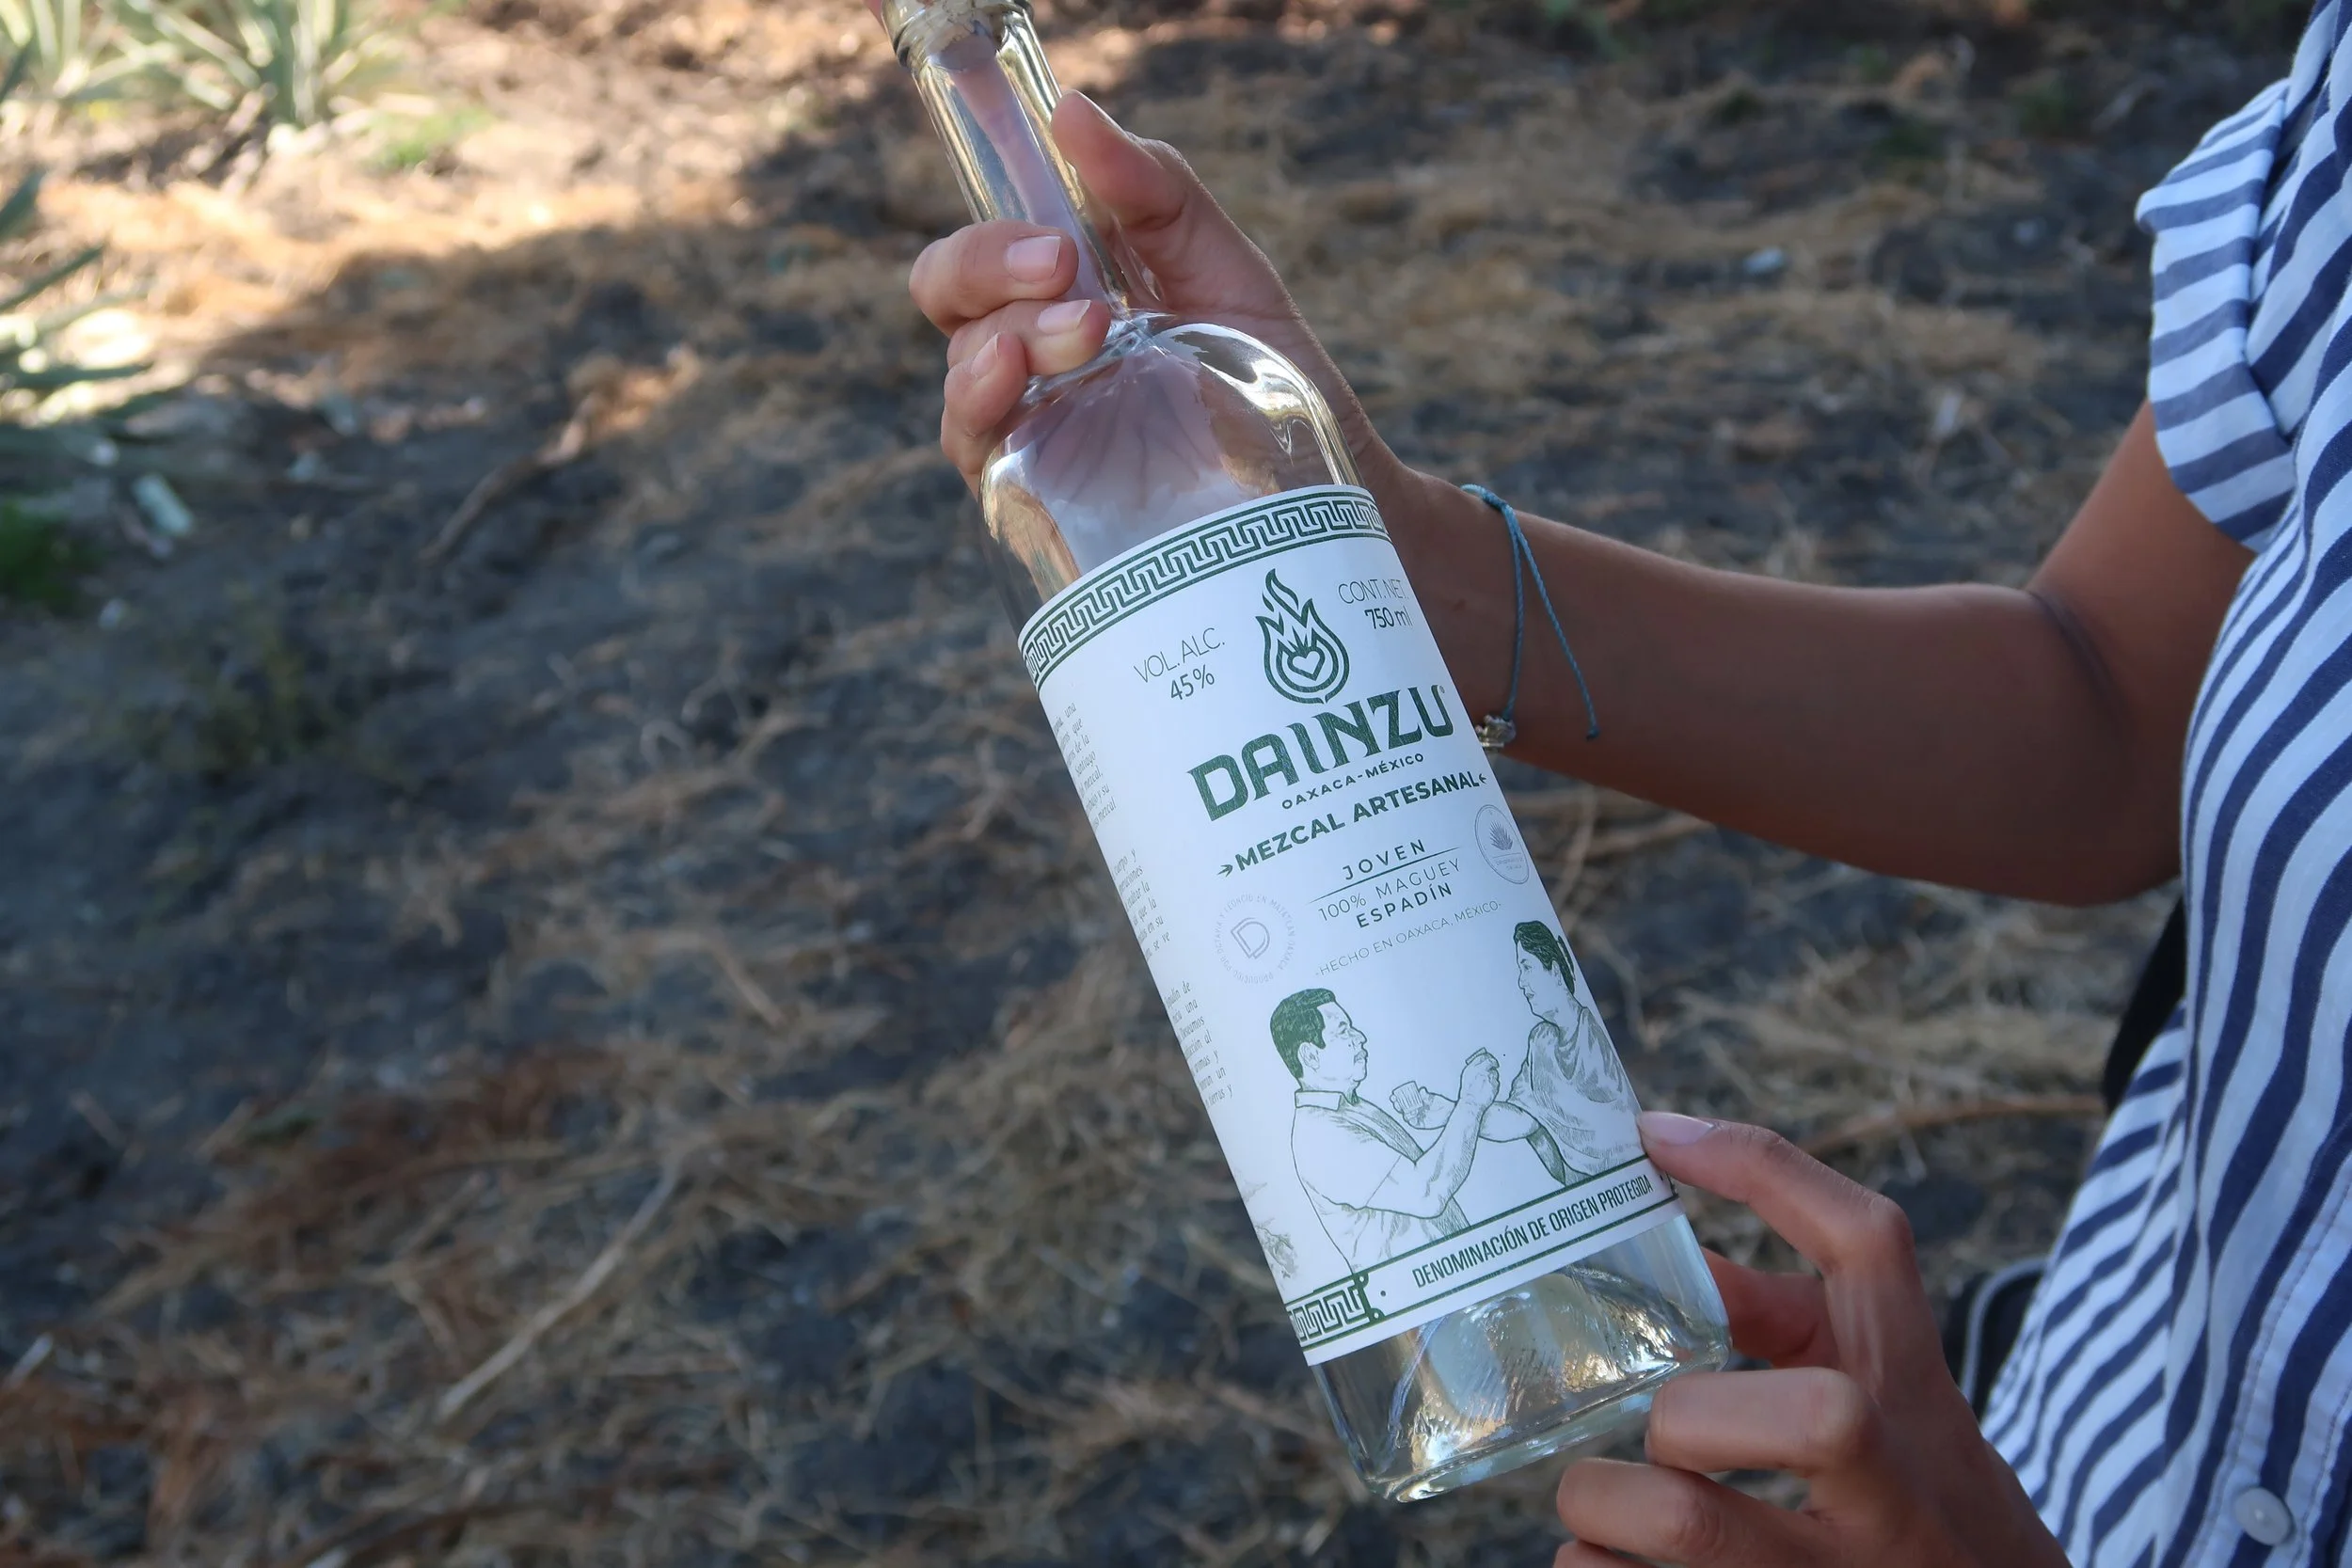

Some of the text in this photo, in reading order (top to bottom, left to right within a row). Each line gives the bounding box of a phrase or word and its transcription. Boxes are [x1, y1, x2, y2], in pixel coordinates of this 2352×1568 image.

[1364, 607, 1394, 629] 750
[1169, 664, 1216, 701] 45%
[1234, 769, 1481, 872] MEZCAL ARTESANAL
[1342, 839, 1426, 880] JOVEN
[1318, 857, 1462, 923] 100% MAGUEY
[1356, 881, 1453, 929] ESPADÍN
[1373, 938, 1394, 954] EN
[1395, 917, 1454, 944] OAXACA,
[1412, 1174, 1654, 1289] DENOMINACIÓN DE ORIGEN PROTEGIDA
